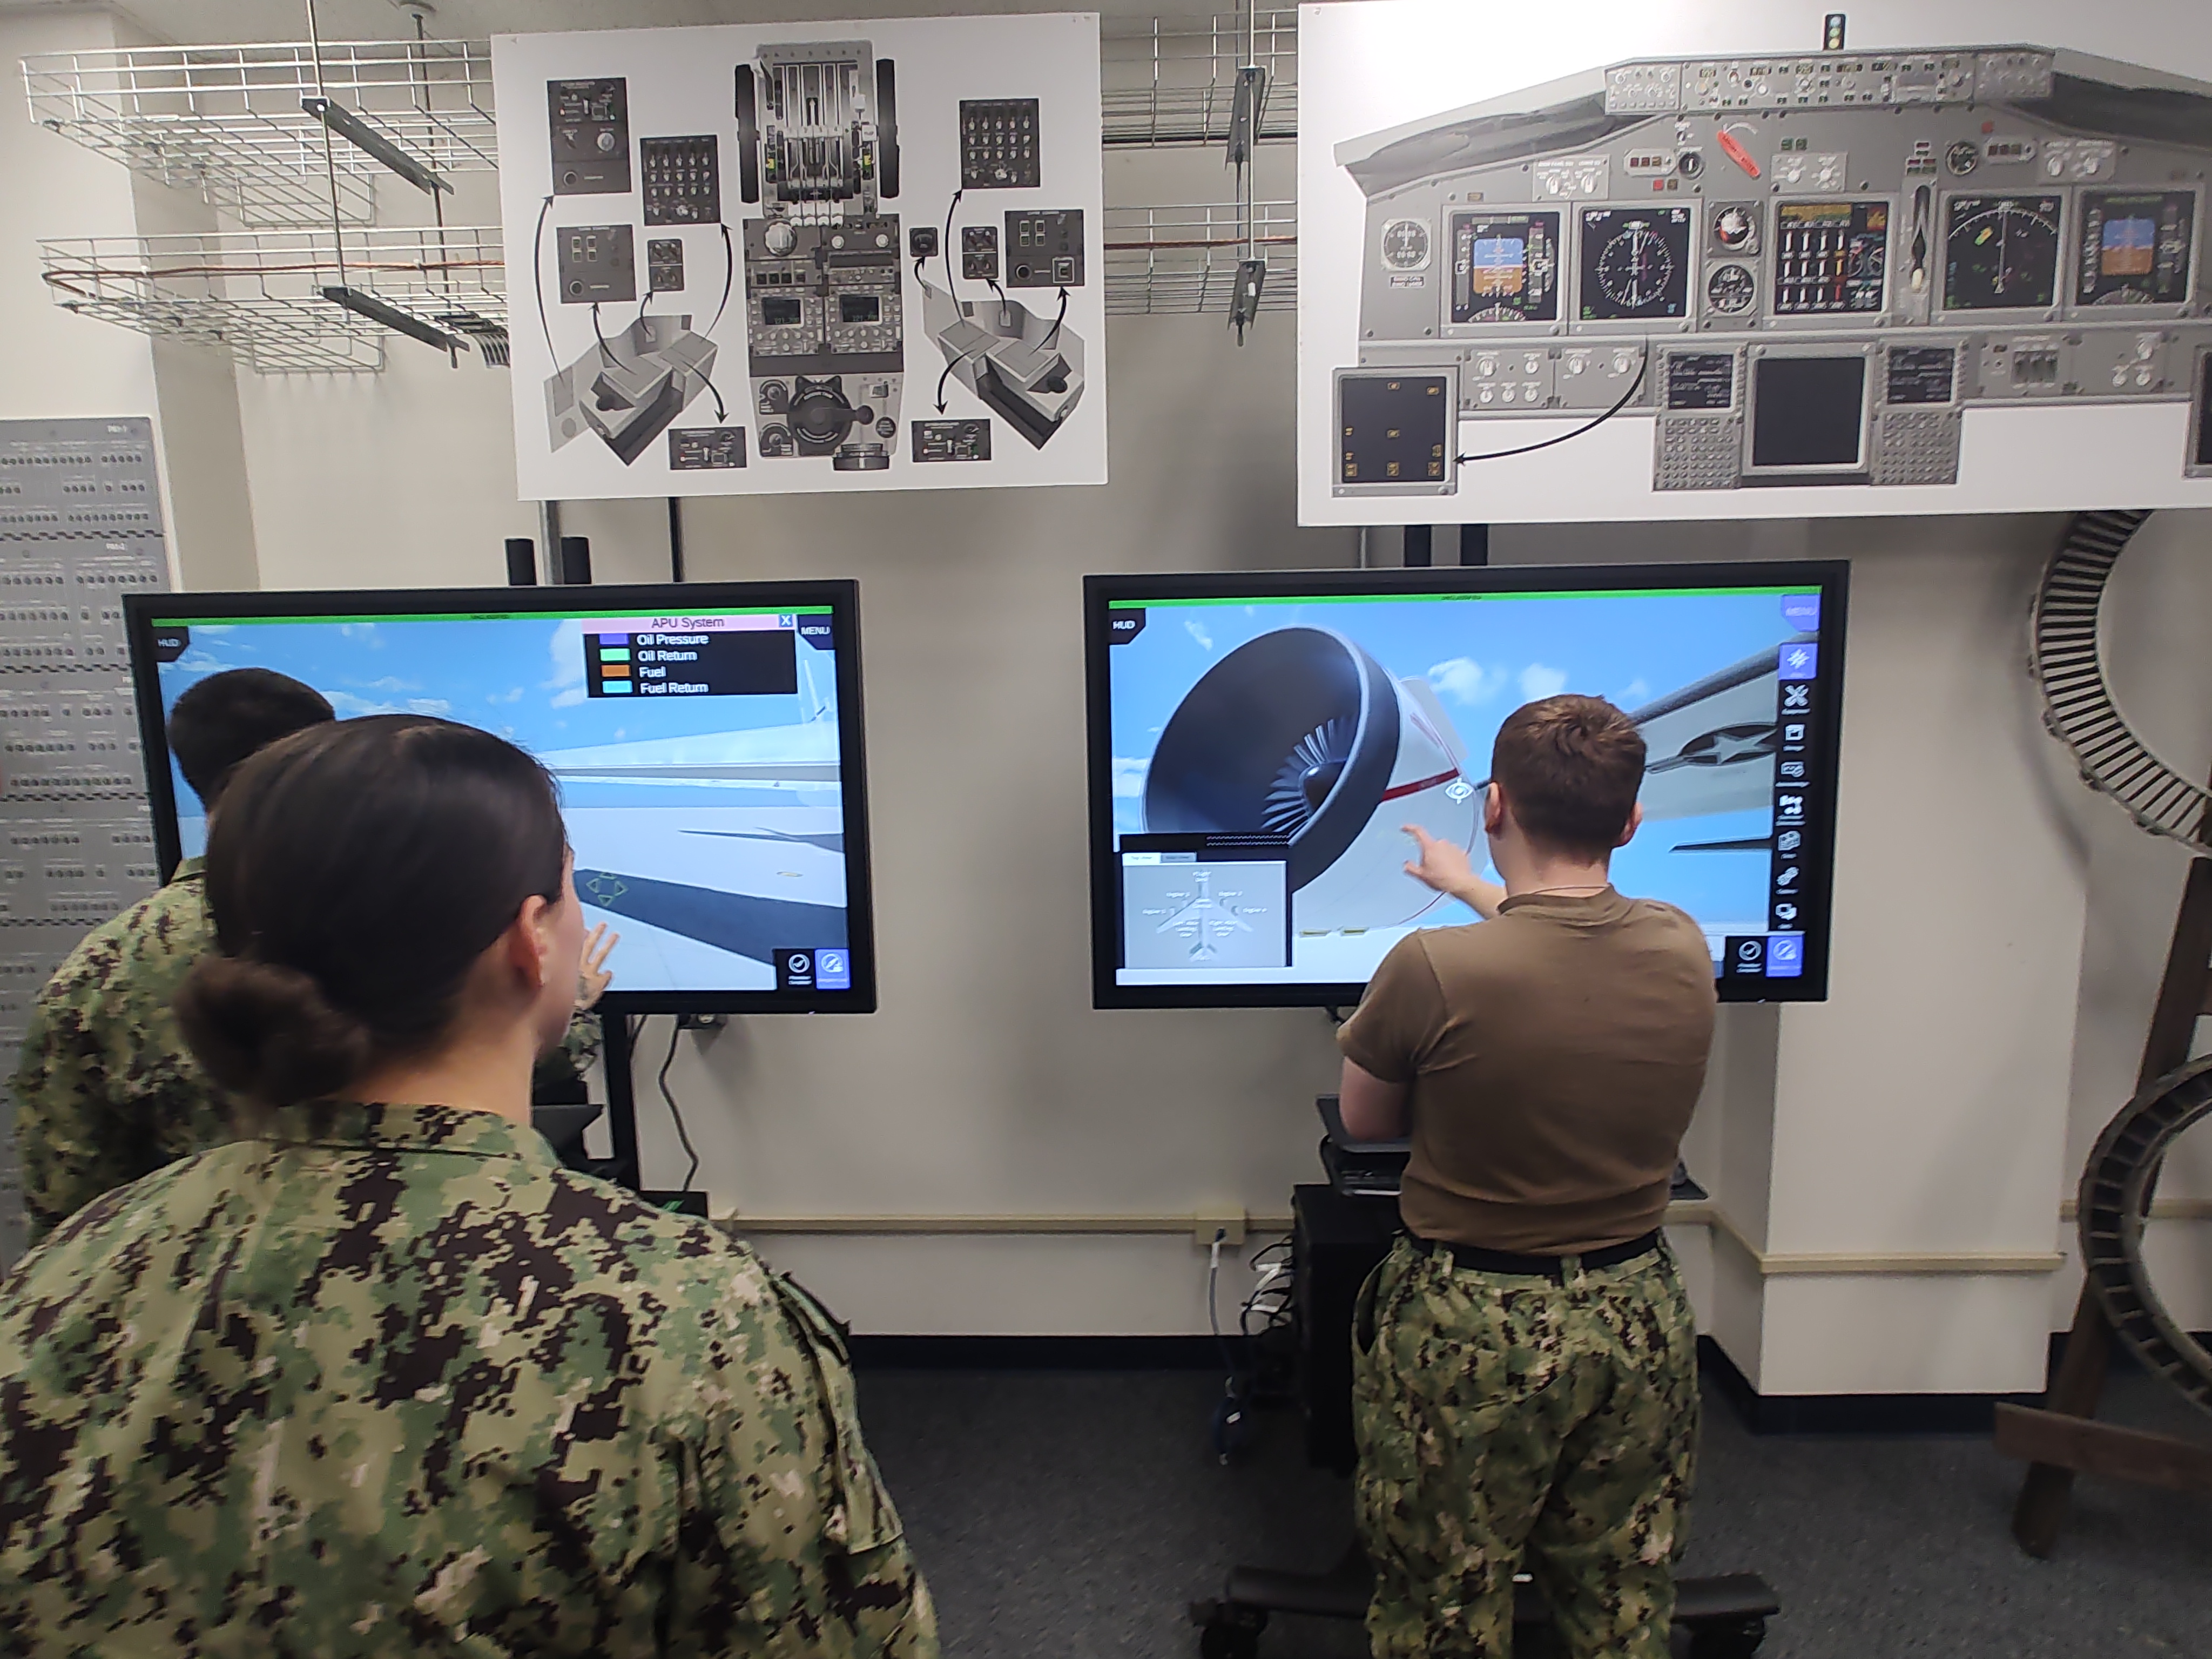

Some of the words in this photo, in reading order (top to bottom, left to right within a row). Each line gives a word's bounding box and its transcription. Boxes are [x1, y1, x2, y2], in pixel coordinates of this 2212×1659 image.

[651, 618, 678, 628] APU
[681, 617, 725, 630] System
[1112, 621, 1136, 629] HUD
[801, 626, 831, 635] MENU
[158, 638, 181, 647] HUD
[637, 634, 655, 645] Oil
[656, 634, 710, 645] Pressure
[638, 650, 656, 662] Oil
[657, 650, 698, 661] Return
[639, 666, 666, 678] Fuel
[640, 682, 667, 694] Fuel
[669, 682, 709, 693] Return
